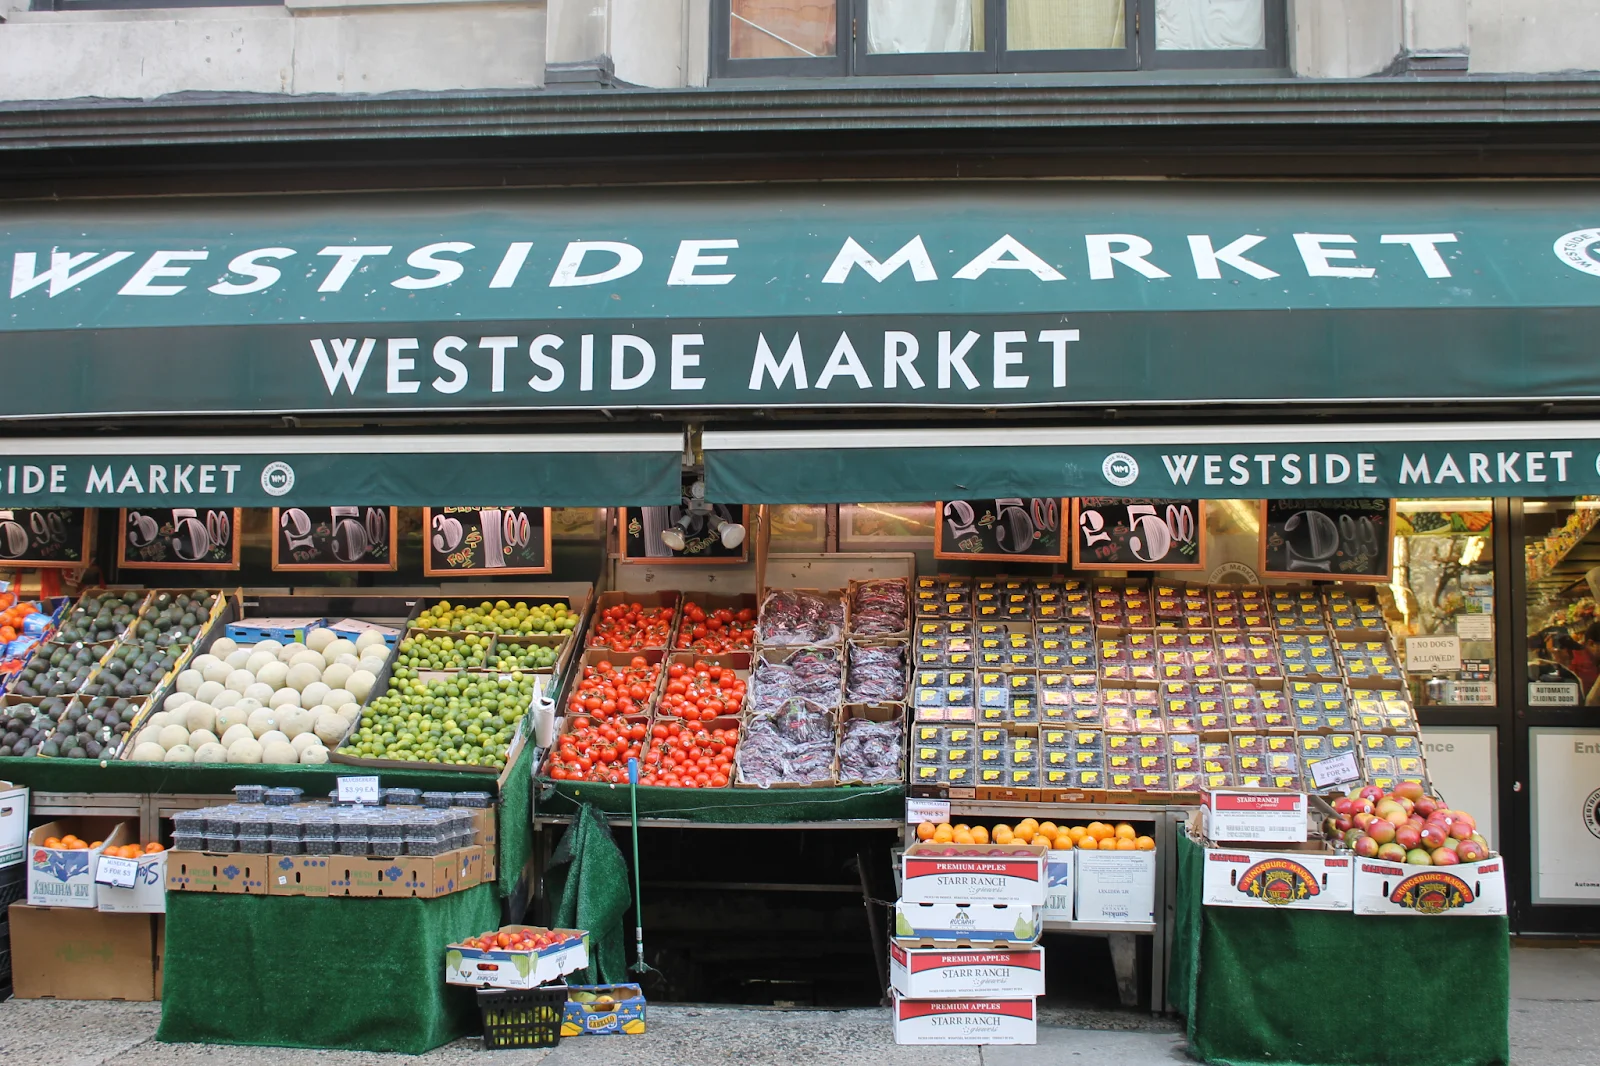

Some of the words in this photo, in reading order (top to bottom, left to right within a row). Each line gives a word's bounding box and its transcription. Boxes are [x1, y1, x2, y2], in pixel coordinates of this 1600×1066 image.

[9, 239, 740, 299] WESTSIDE
[821, 231, 1459, 286] MARKET
[309, 333, 706, 396] WESTSIDE
[748, 328, 1080, 391] MARKET
[1161, 453, 1378, 486] WESTSIDE
[1399, 450, 1573, 485] MARKET
[85, 464, 241, 494] MARKET
[128, 510, 159, 548] 3
[280, 507, 315, 550] 2
[432, 514, 464, 554] 3
[1079, 509, 1112, 547] 2
[446, 546, 475, 568] FOR
[1229, 563, 1258, 584] MARKET
[1417, 641, 1429, 649] NO
[1533, 695, 1558, 703] SLIDING
[1558, 695, 1575, 703] DOOR
[1326, 769, 1341, 778] FOR
[1236, 796, 1257, 804] STARR
[1257, 796, 1280, 804] RANCH
[936, 863, 975, 871] PREMIUM
[976, 863, 1007, 871] APPLES
[1245, 860, 1288, 884] KINGSBURG
[1289, 863, 1315, 887] MAIDEN
[32, 880, 72, 897] WHITNEY
[937, 876, 968, 886] STARR
[970, 876, 1007, 887] RANCH
[1397, 873, 1442, 896] KINGSBURG
[1443, 873, 1469, 896] MAIDEN
[1101, 909, 1129, 919] Sunkist
[941, 955, 981, 964] PREMIUM
[981, 954, 1011, 963] APPLES
[942, 968, 973, 979] STARR
[975, 967, 1010, 978] RANCH
[931, 1016, 963, 1026] STARR
[964, 1016, 1001, 1026] RANCH
